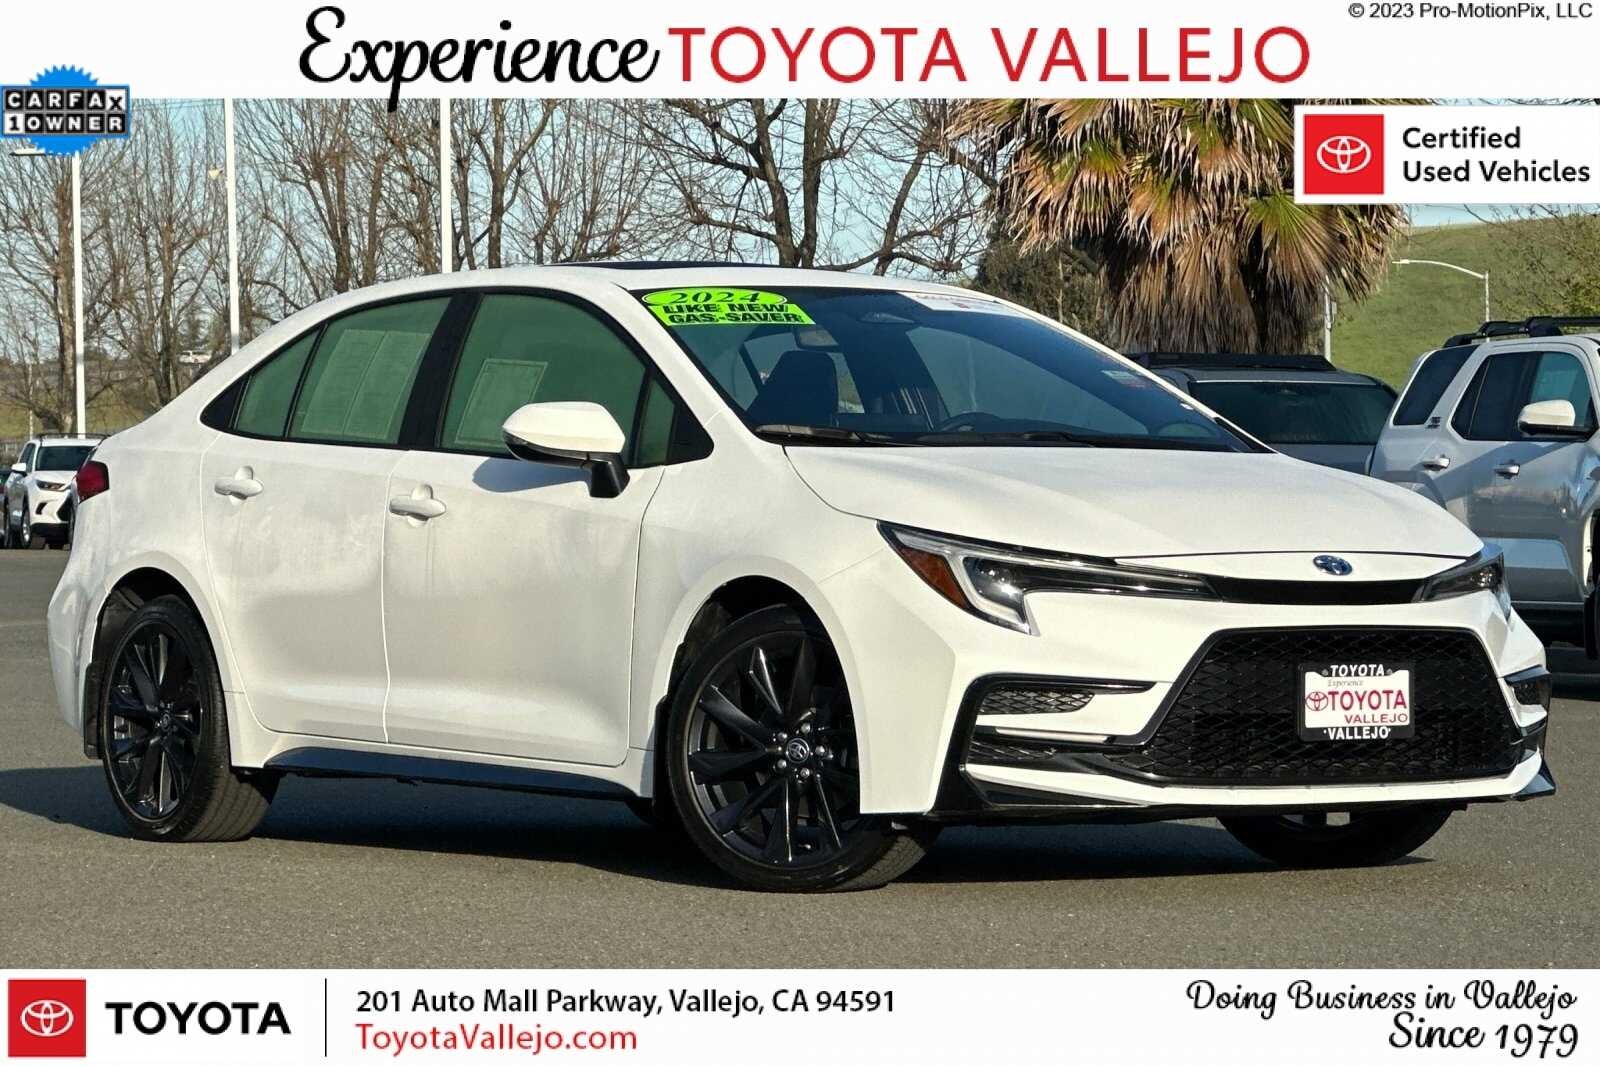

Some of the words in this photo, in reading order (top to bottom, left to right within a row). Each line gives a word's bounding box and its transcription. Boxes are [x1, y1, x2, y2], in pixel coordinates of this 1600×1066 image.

[669, 292, 761, 304] 2024
[662, 304, 718, 314] LIKE
[728, 303, 788, 313] NEW
[1330, 664, 1385, 677] TOYOTA
[1328, 690, 1407, 711] TOYOTA
[1344, 713, 1408, 724] VALLEJO
[1328, 726, 1390, 740] VALLEJO
